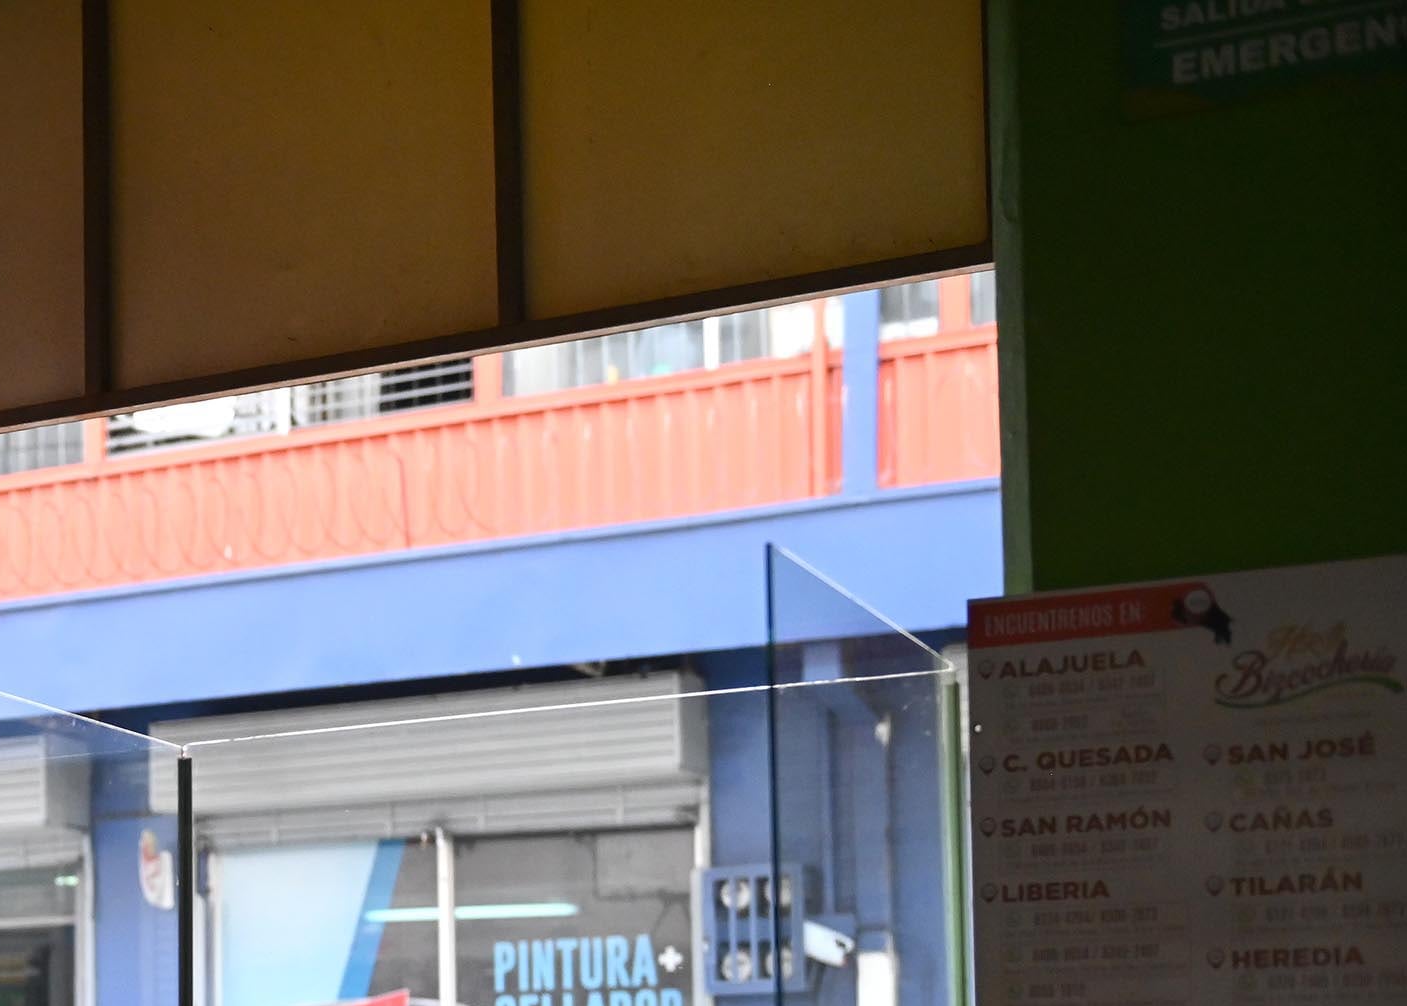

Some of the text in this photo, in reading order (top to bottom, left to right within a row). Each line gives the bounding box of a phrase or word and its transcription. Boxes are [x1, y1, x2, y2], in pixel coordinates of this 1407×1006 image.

[983, 603, 1113, 638] ENCUENTRENOS
[999, 649, 1145, 680] ALAJUELA
[1002, 742, 1175, 773] C. QUESADA
[1227, 731, 1376, 765] SAN JOSÉ
[1001, 805, 1172, 838] SAN RAMÓN
[1228, 804, 1334, 833] CAÑAS
[1001, 879, 1111, 903] LIBERIA
[1229, 867, 1364, 897] TILARÁN
[493, 934, 658, 992] PINTURA
[1231, 946, 1365, 970] HEREDIA
